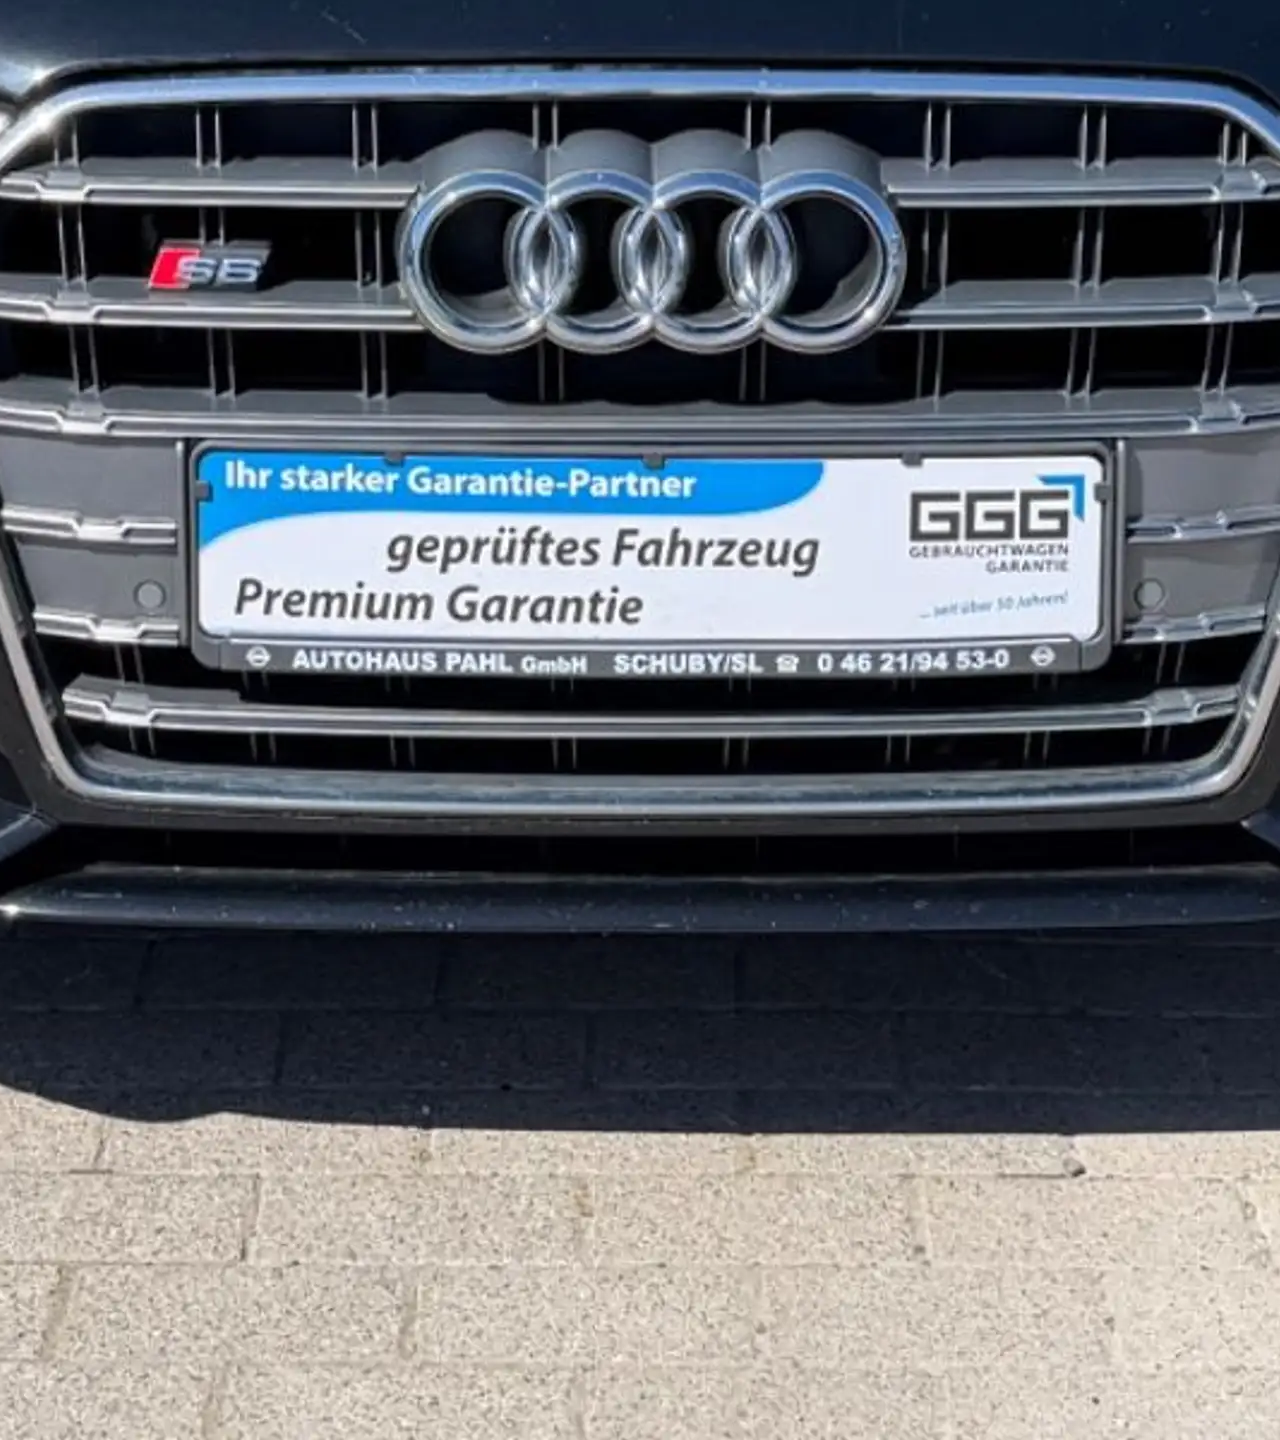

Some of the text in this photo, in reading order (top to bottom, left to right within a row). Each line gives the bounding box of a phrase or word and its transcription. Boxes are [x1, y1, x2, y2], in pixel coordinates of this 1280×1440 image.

[225, 460, 697, 498] Ihr starker Garantie-Partner
[909, 490, 1070, 542] GGG
[387, 525, 820, 576] geprüftes Fahrzeug
[908, 543, 1070, 559] GEBRAUCHTWAGEN
[984, 559, 1070, 574] GARANTIE
[234, 577, 644, 625] Premium Garantie
[292, 648, 1011, 675] AUTOHAUS PAHL GmbH SCHUBY/SL 0 46 21/94 53-0
